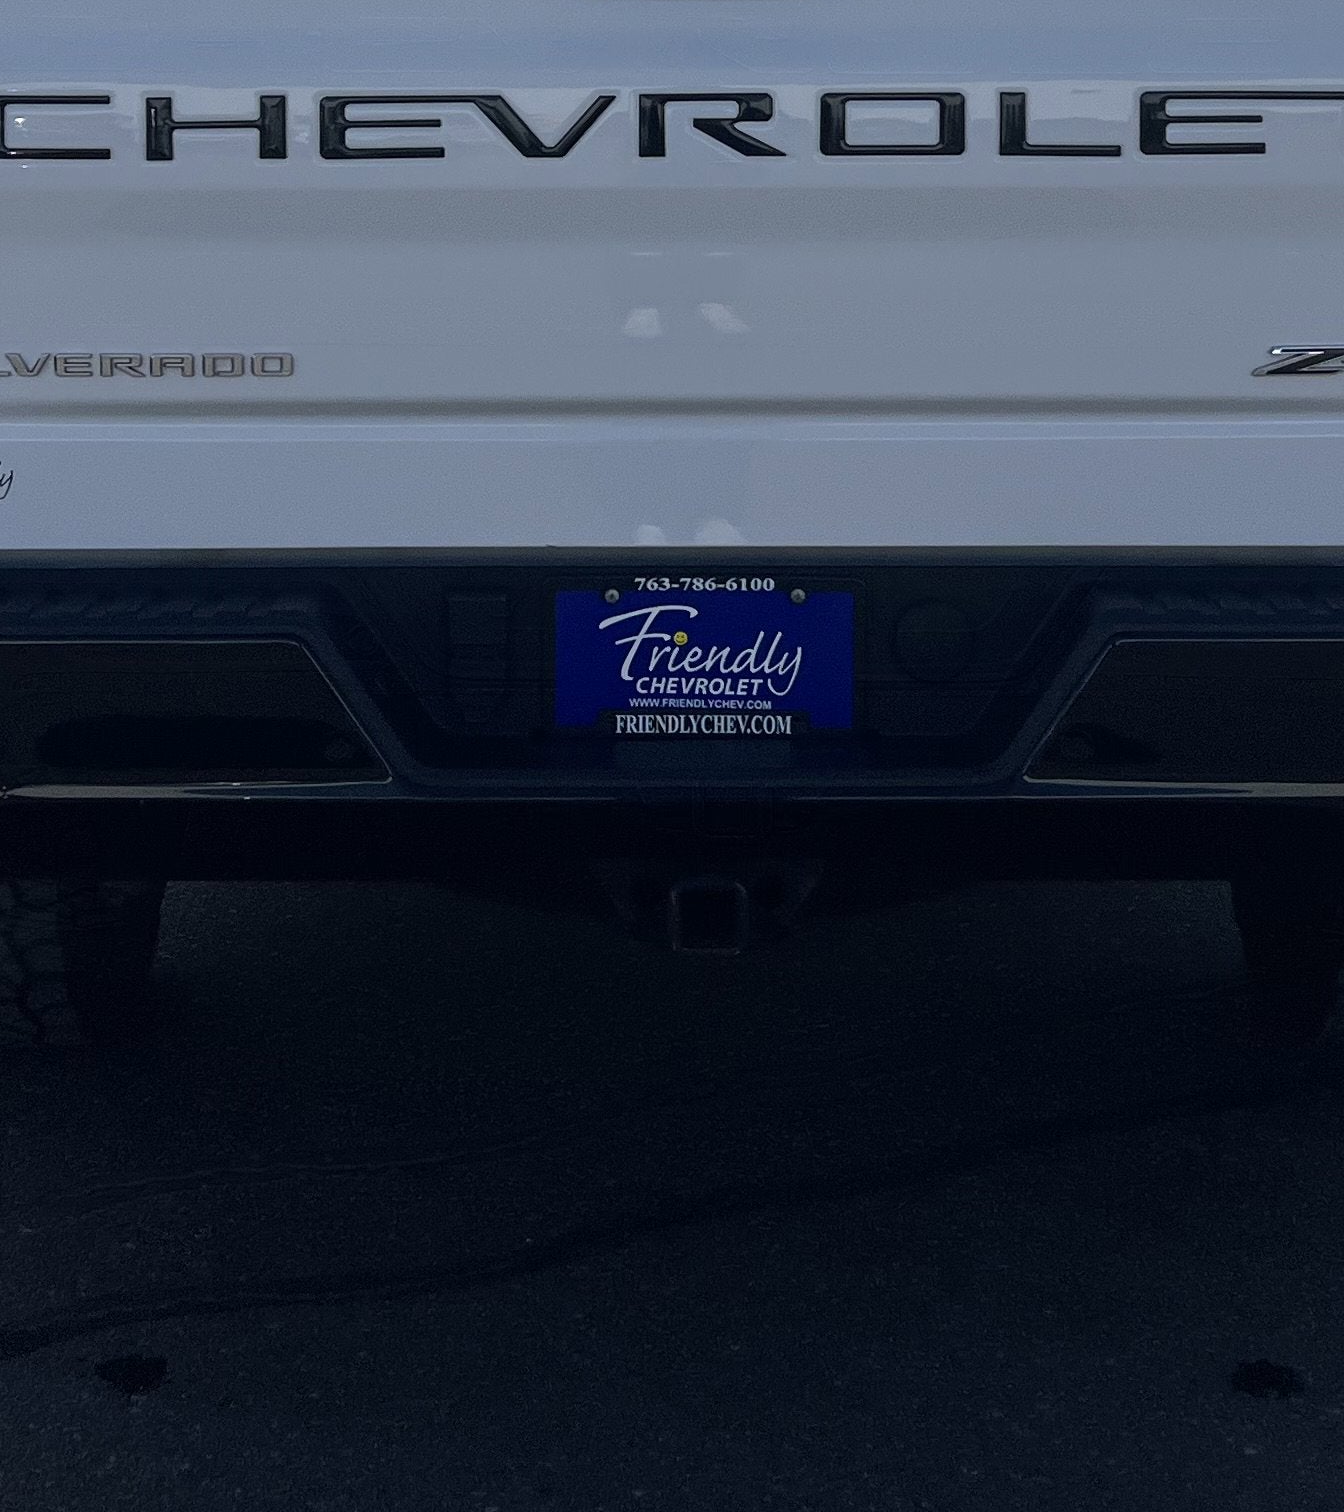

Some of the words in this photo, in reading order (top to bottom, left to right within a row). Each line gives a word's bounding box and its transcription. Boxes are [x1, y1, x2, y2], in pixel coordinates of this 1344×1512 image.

[634, 577, 776, 592] 763-786-6100
[598, 604, 803, 696] Friendly
[635, 676, 764, 696] CHEVROLET
[628, 697, 773, 711] WWW.FRIENDLYCHEV.COM
[614, 713, 793, 736] FRIENDLYCHEV.COM
